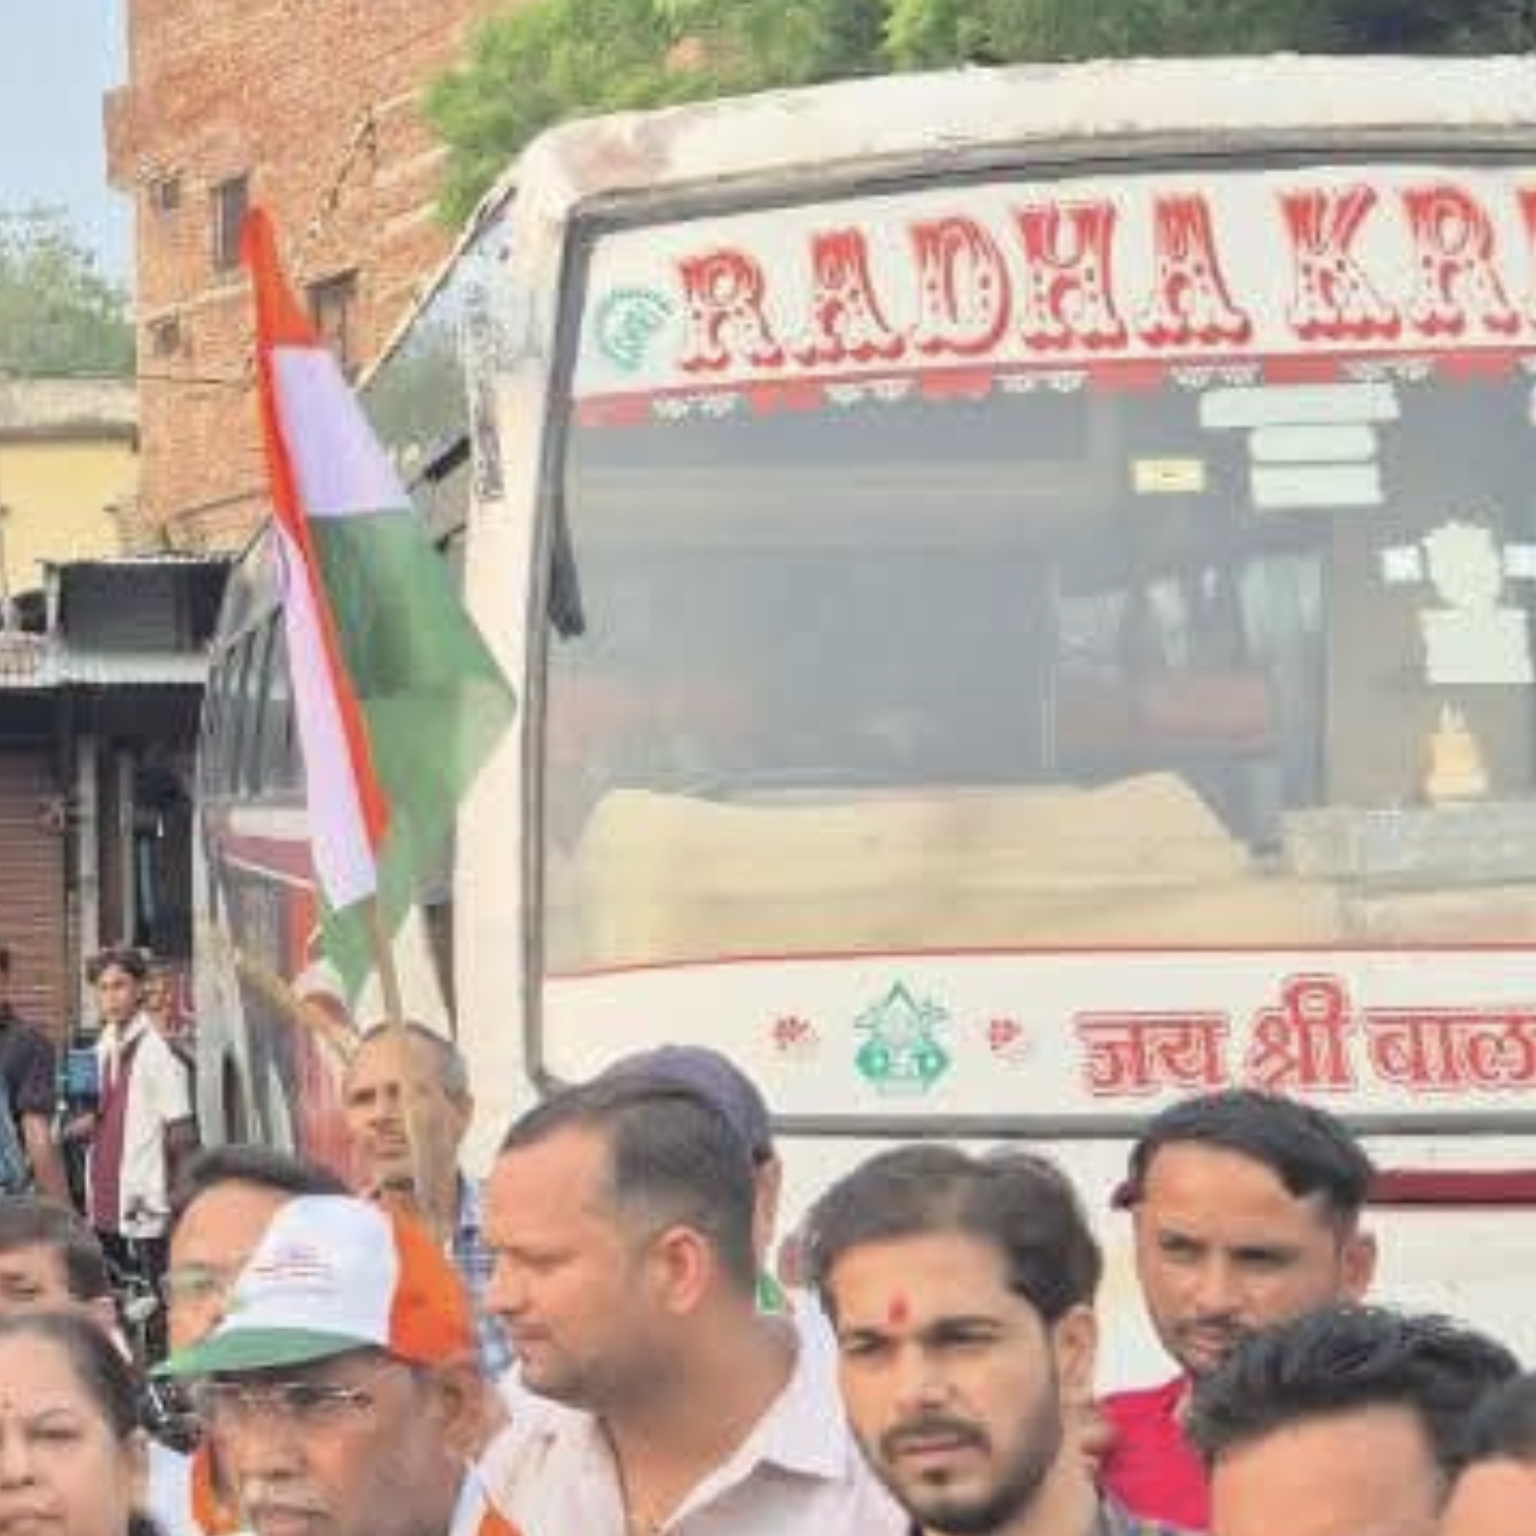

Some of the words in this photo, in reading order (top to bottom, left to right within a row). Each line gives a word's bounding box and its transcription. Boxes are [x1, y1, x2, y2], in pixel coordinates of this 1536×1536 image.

[676, 189, 1252, 374] RADHA
[1274, 182, 1536, 340] KR
[1075, 1011, 1230, 1096] जय
[1242, 972, 1352, 1095] श्री
